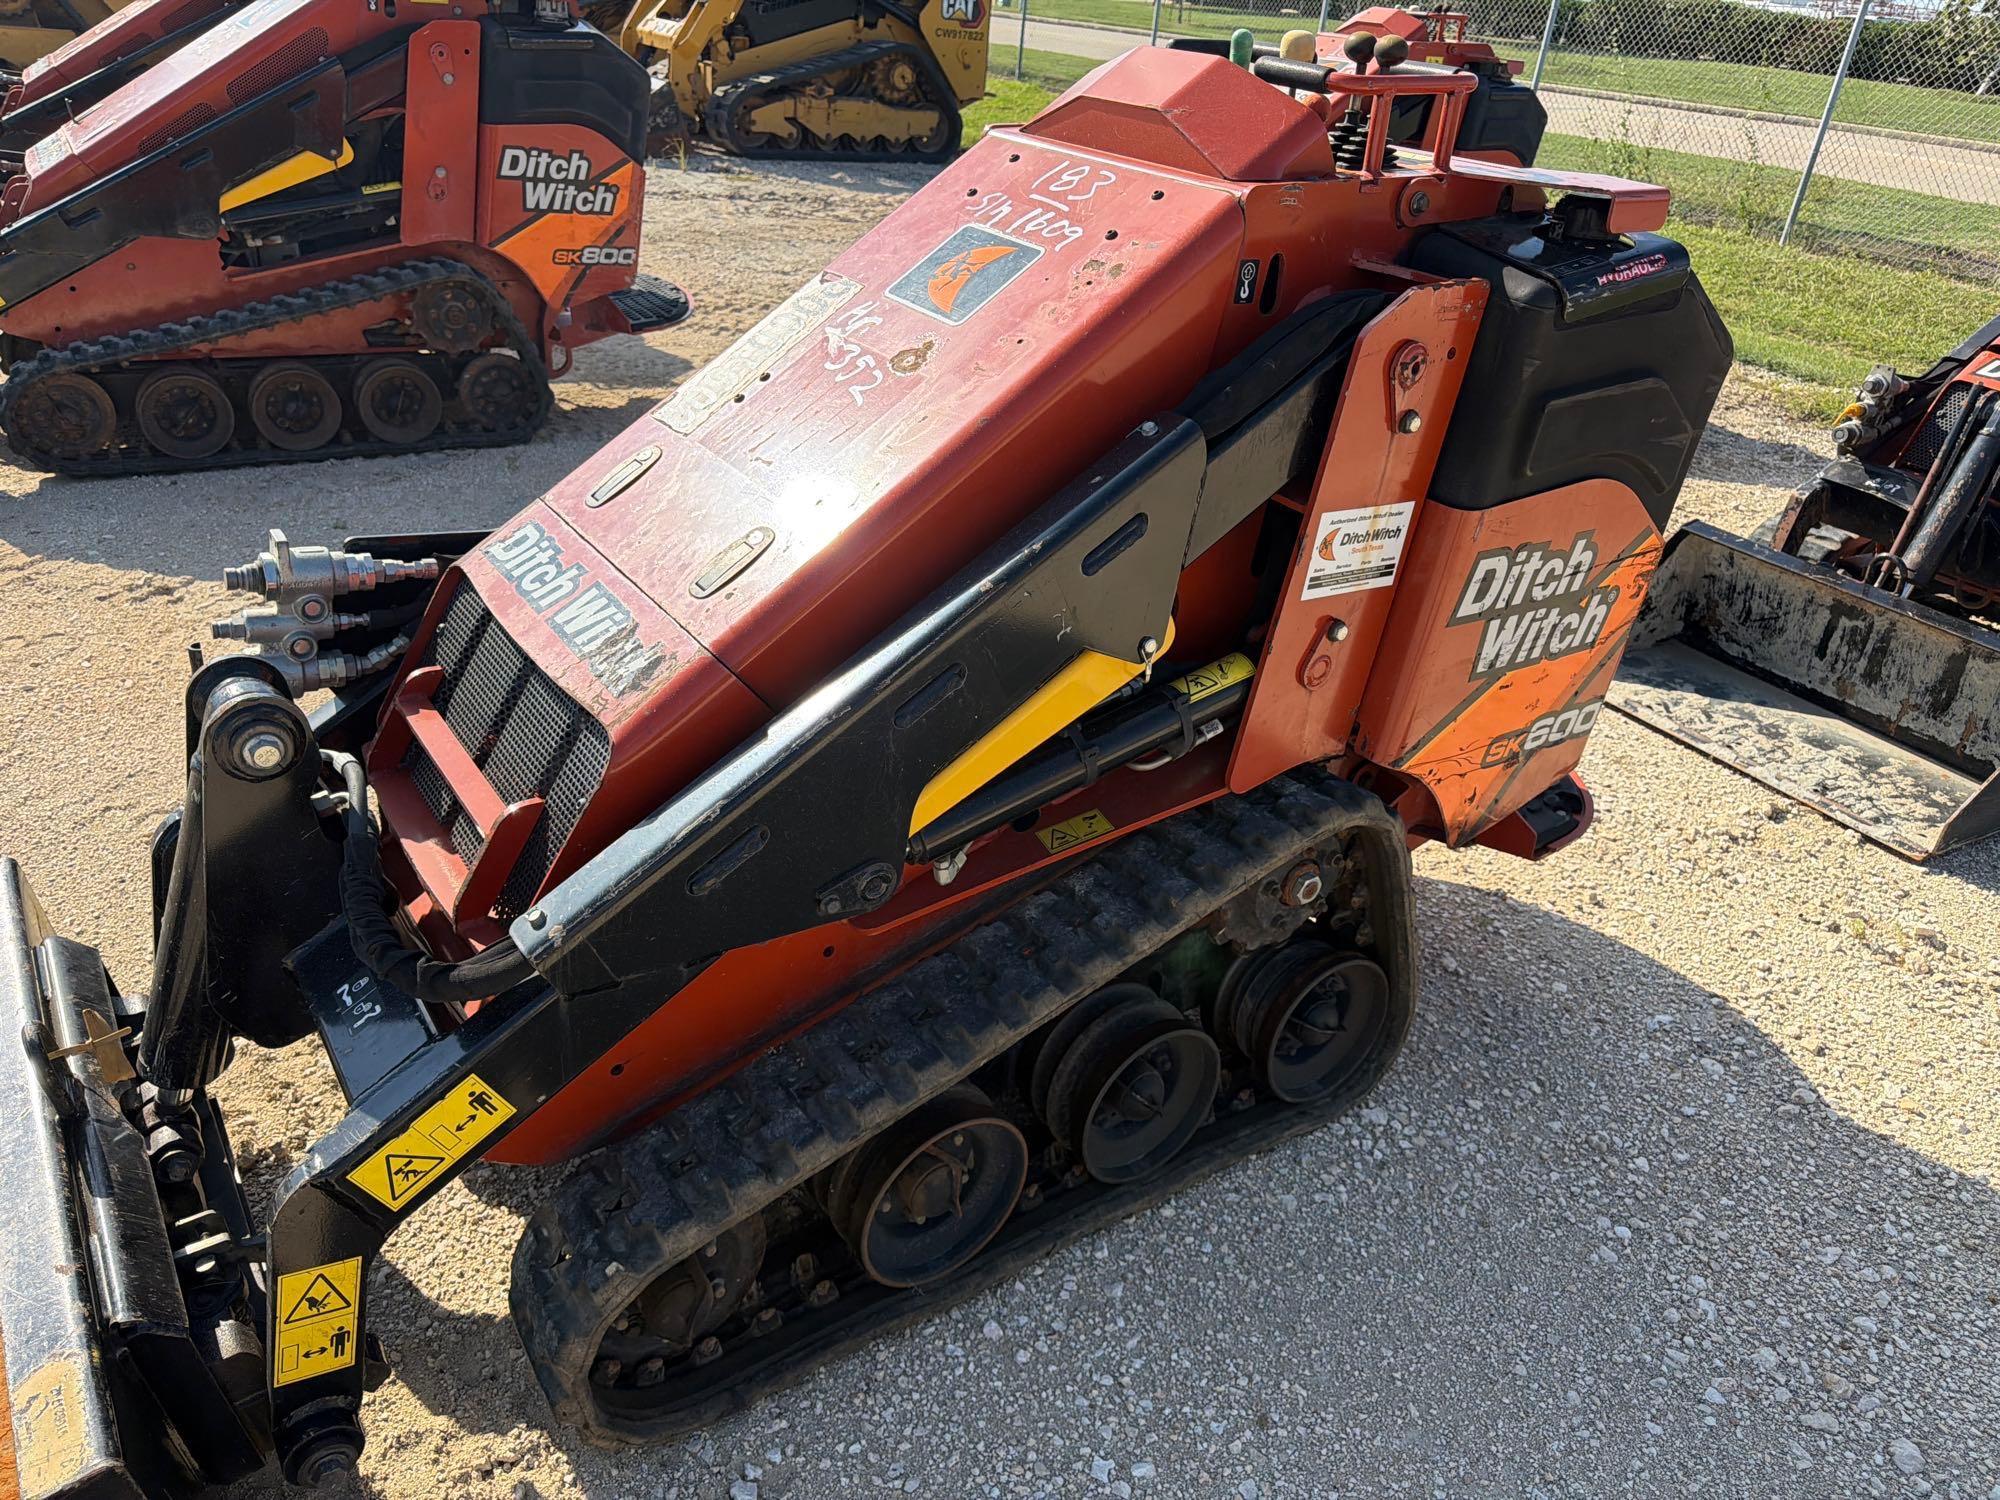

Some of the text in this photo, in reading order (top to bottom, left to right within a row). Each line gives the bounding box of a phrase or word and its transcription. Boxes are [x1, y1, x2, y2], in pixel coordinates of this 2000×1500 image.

[943, 0, 978, 20] CAT
[500, 149, 589, 180] Ditch
[1032, 160, 1117, 200] 183
[1005, 208, 1083, 252] 1609
[554, 247, 637, 264] SK800
[1329, 517, 1358, 526] Authorized
[1340, 530, 1370, 547] Ditch
[1351, 544, 1384, 554] South Texas
[484, 524, 579, 610] Ditch
[1456, 538, 1593, 618] Ditch
[1485, 702, 1601, 762] SK600
